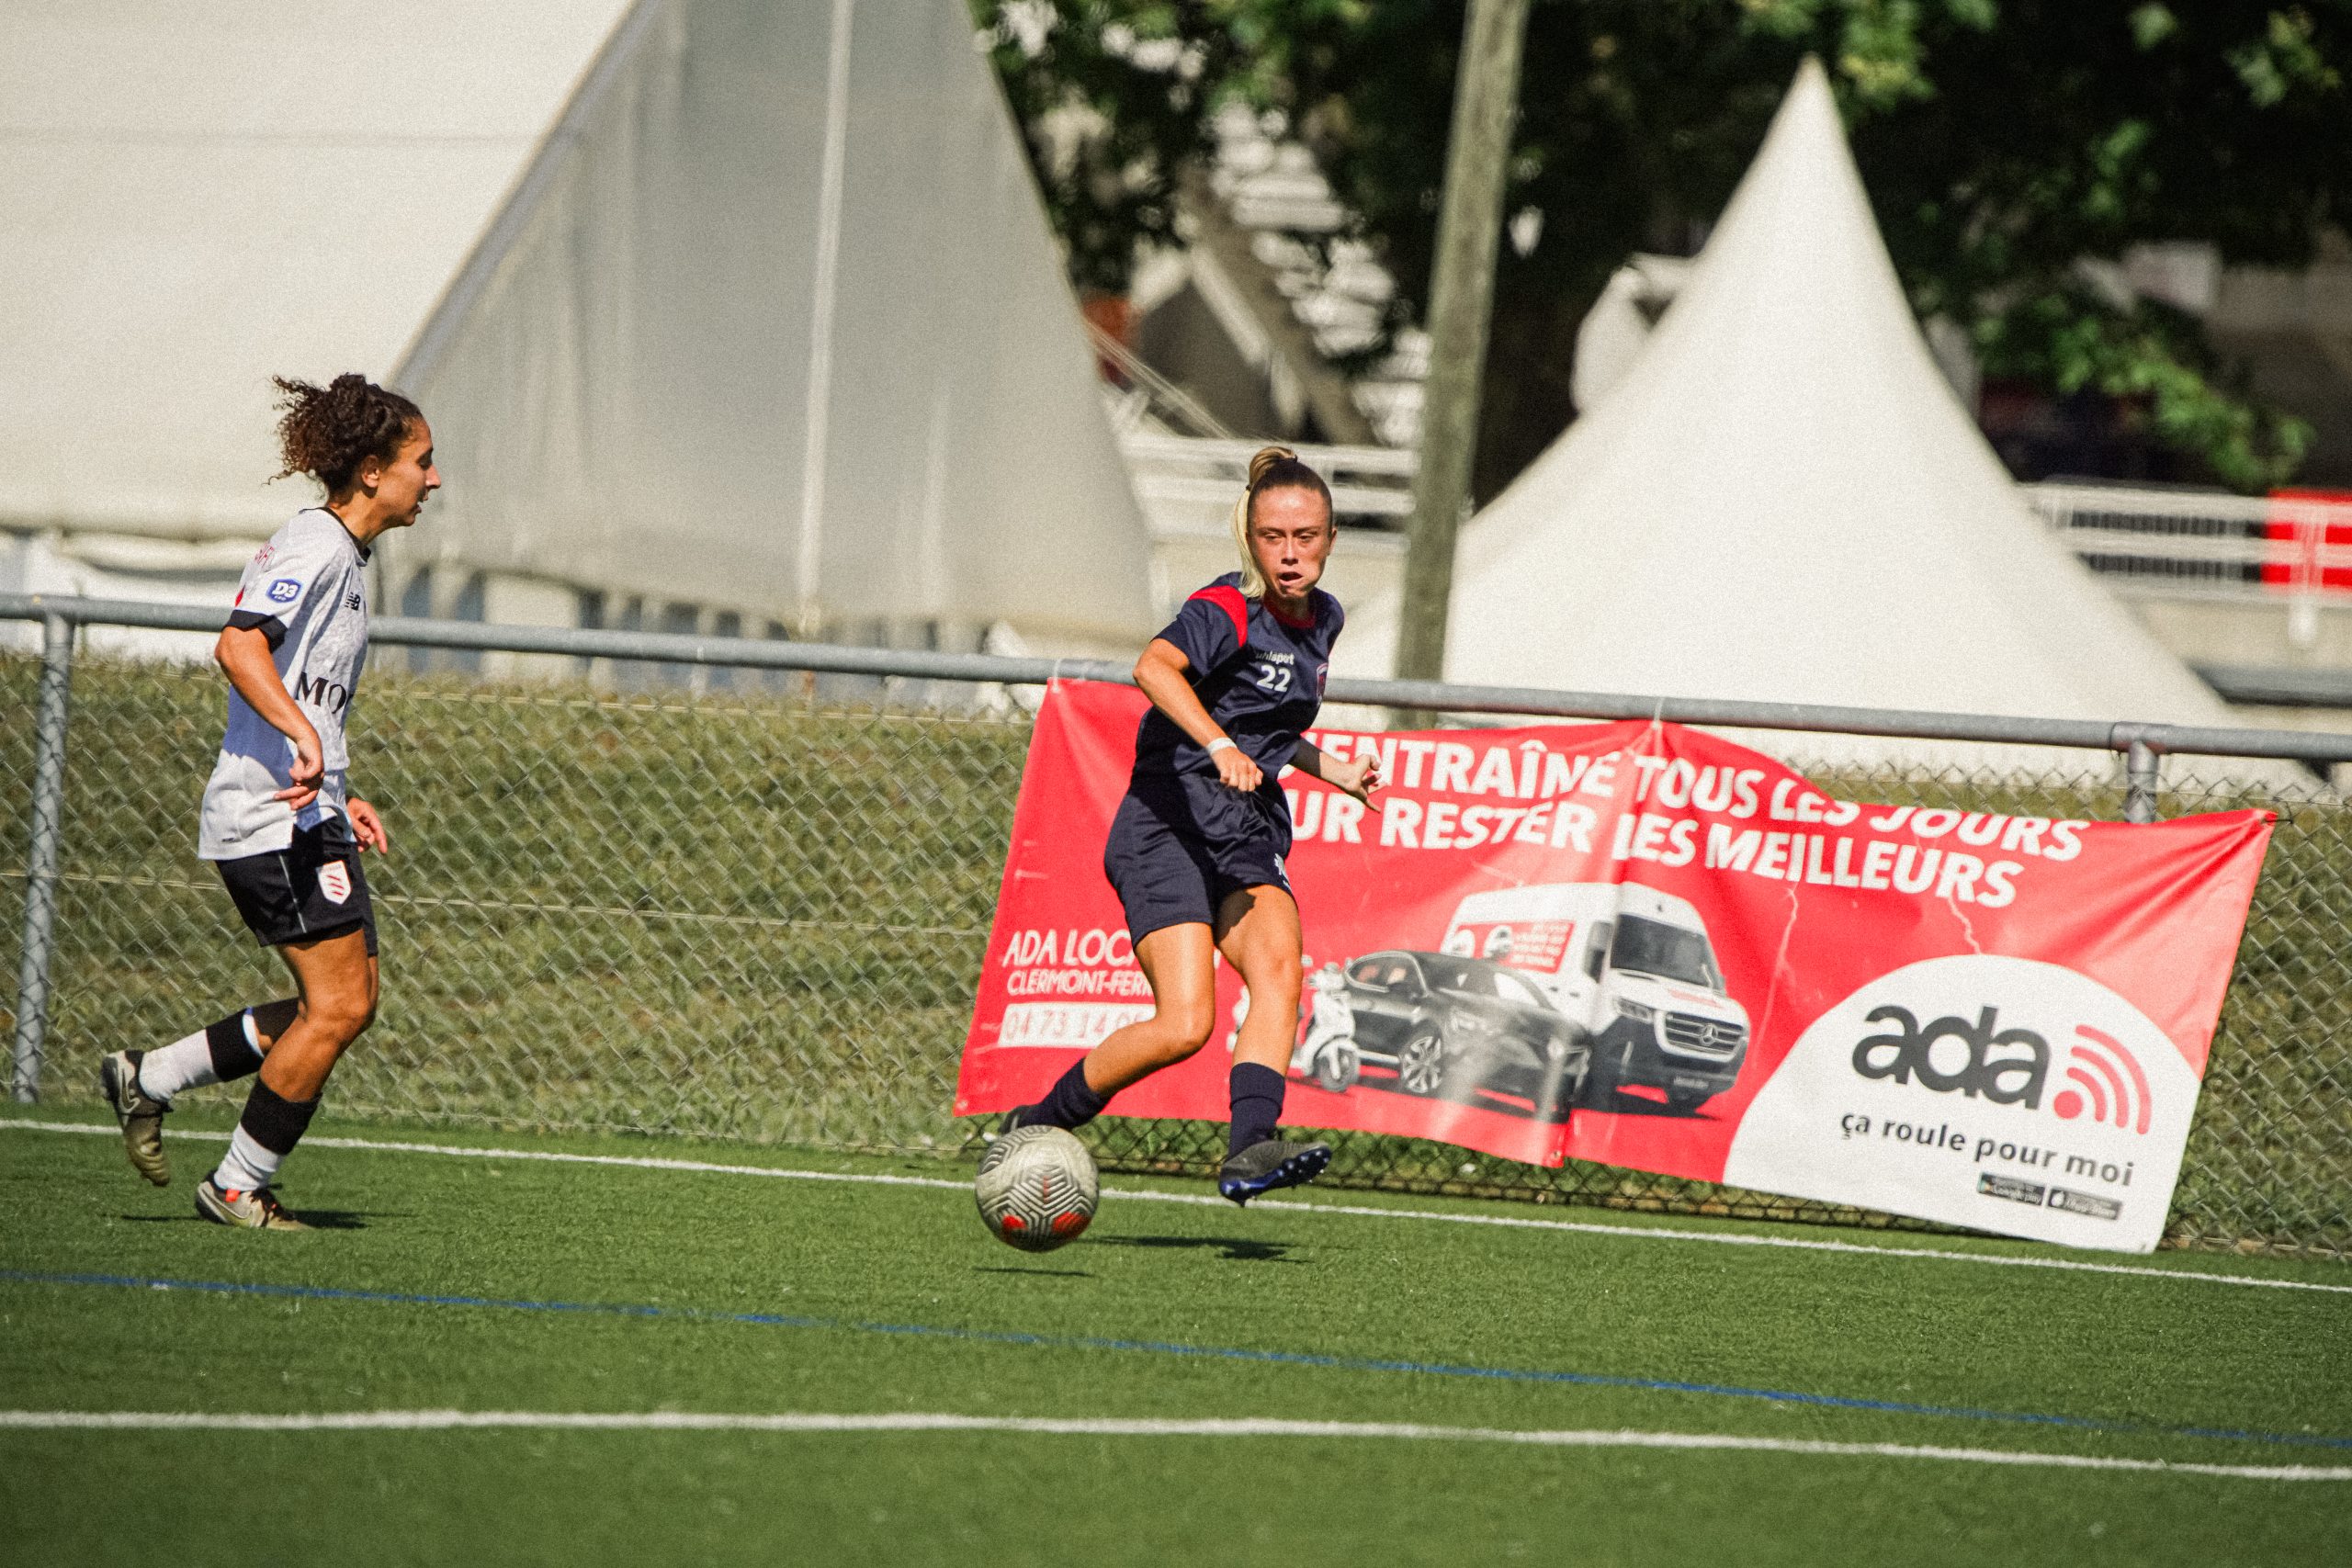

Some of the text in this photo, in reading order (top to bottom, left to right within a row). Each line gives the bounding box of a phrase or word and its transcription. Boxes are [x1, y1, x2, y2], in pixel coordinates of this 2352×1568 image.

[272, 581, 299, 598] D3
[1256, 664, 1292, 693] 22
[1277, 731, 2092, 862] 'ENTRAÎNE TOUS LES JOURS
[1284, 787, 1366, 844] UR
[1379, 796, 1598, 854] RESTER
[1704, 822, 2026, 908] MEILLEURS
[1001, 928, 1136, 967] ADA LOC
[1851, 1005, 2052, 1110] ada
[1840, 1111, 1871, 1141] ça
[1883, 1121, 1967, 1152] roule
[1973, 1135, 2059, 1167] pour
[2064, 1155, 2136, 1186] moi
